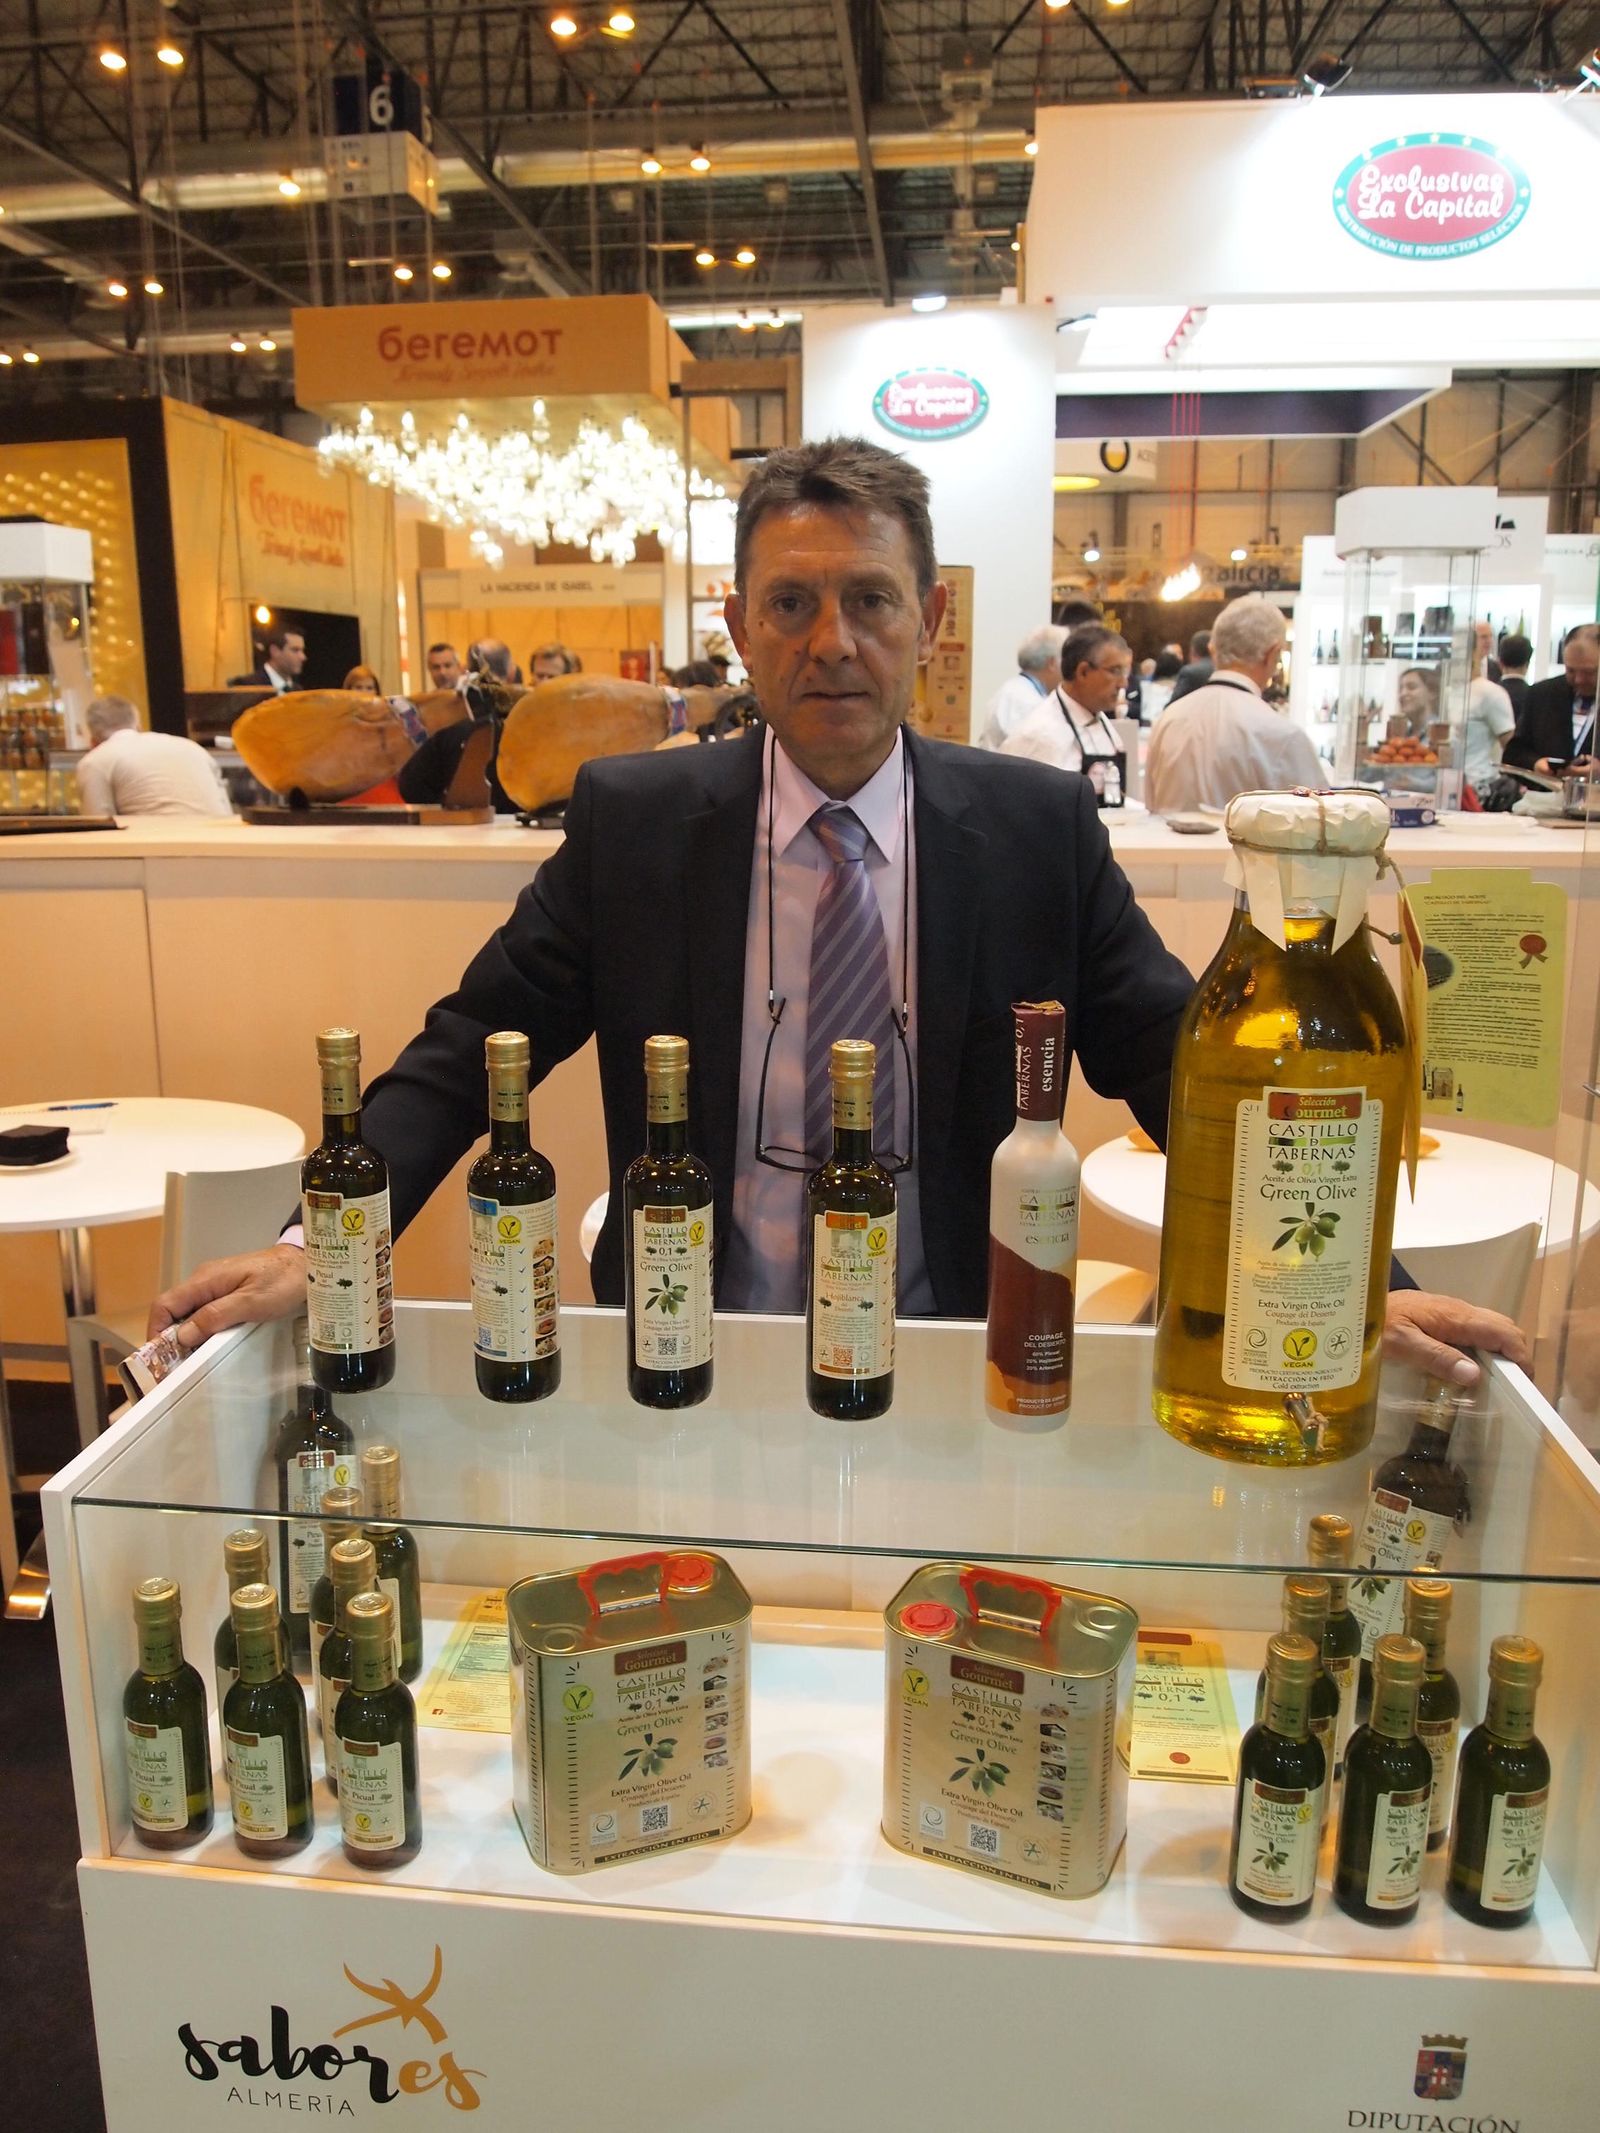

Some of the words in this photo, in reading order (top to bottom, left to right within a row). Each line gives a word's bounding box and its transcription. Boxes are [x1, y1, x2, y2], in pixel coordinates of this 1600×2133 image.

[369, 84, 394, 126] 6
[1357, 190, 1396, 220] La
[1404, 191, 1504, 225] Capital
[377, 325, 564, 362] бегемот
[1041, 1037, 1056, 1092] esencia
[1020, 1046, 1032, 1110] TABERNAS
[1268, 1122, 1359, 1137] CASTILLO
[1266, 1144, 1356, 1161] TABERNAS
[1302, 1162, 1323, 1177] 0,1
[1262, 1174, 1286, 1182] Aceite
[1297, 1175, 1317, 1183] Oliva
[1318, 1176, 1341, 1185] Virgen
[1260, 1184, 1310, 1201] Green
[1316, 1185, 1357, 1200] Olive
[643, 1226, 688, 1234] CASTILLO
[643, 1237, 688, 1245] TABERNAS
[658, 1247, 672, 1257] 0,1
[640, 1261, 666, 1273] Green
[668, 1263, 693, 1273] Olive
[820, 1256, 874, 1268] CASTILLO
[820, 1270, 873, 1282] TABERNAS
[1258, 1300, 1279, 1309] Extra
[1281, 1301, 1308, 1312] Virgin
[1310, 1301, 1332, 1310] Olive
[1333, 1299, 1345, 1308] Oil
[1298, 1311, 1310, 1319] del
[1028, 1331, 1064, 1341] COUPAGE
[1378, 1547, 1402, 1563] Olive
[624, 1652, 676, 1672] Gourmet
[616, 1667, 686, 1689] CASTILLO
[960, 1668, 1015, 1691] Gourmet
[617, 1682, 686, 1704] TABERNAS
[952, 1683, 1022, 1708] CASTILLO
[1136, 1685, 1206, 1695] ABERNAS
[902, 1695, 929, 1708] VEGAN
[1158, 1693, 1181, 1703] 0,1
[644, 1699, 662, 1713] 0,1
[952, 1697, 1021, 1722] TABERNAS
[564, 1713, 594, 1722] VEGAN
[977, 1715, 997, 1730] 0,1
[617, 1723, 651, 1737] Green
[653, 1715, 684, 1729] Olive
[950, 1728, 984, 1747] Green
[986, 1739, 1017, 1755] Olive
[610, 1787, 631, 1798] Extra
[631, 1782, 655, 1794] Virgin
[657, 1777, 678, 1786] Olive
[679, 1773, 692, 1781] Oil
[352, 1791, 375, 1801] Picual
[941, 1787, 960, 1800] Extra
[961, 1794, 985, 1808] Virgin
[987, 1800, 1009, 1814] Olive
[1009, 1808, 1024, 1818] Oil
[671, 1838, 683, 1847] EN
[999, 1870, 1014, 1879] EN
[178, 2005, 487, 2111] sabores
[227, 2086, 355, 2117] ALMERÍA
[1348, 2109, 1521, 2133] DIPUTACIÓN
